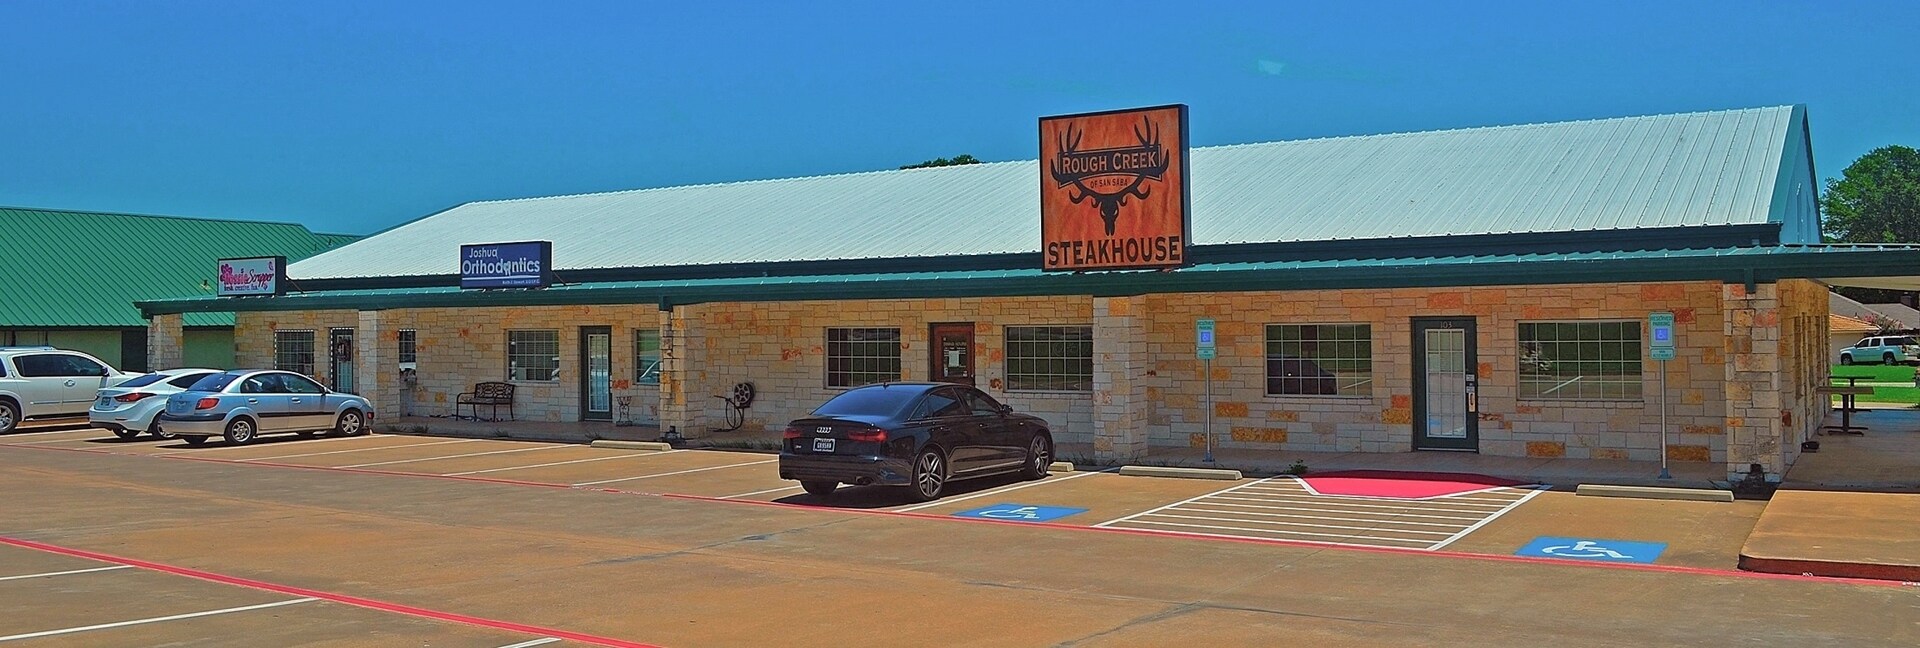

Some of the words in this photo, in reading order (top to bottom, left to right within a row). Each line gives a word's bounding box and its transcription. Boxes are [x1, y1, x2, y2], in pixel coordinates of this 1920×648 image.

[1062, 154, 1108, 174] ROUGH
[1112, 151, 1157, 171] CREEK
[1090, 180, 1098, 189] OF
[1099, 178, 1111, 187] SAN
[1112, 177, 1128, 187] SABA
[469, 246, 498, 259] Joshua
[1048, 236, 1180, 266] STEAKHOUSE
[462, 257, 540, 276] Orthodontics
